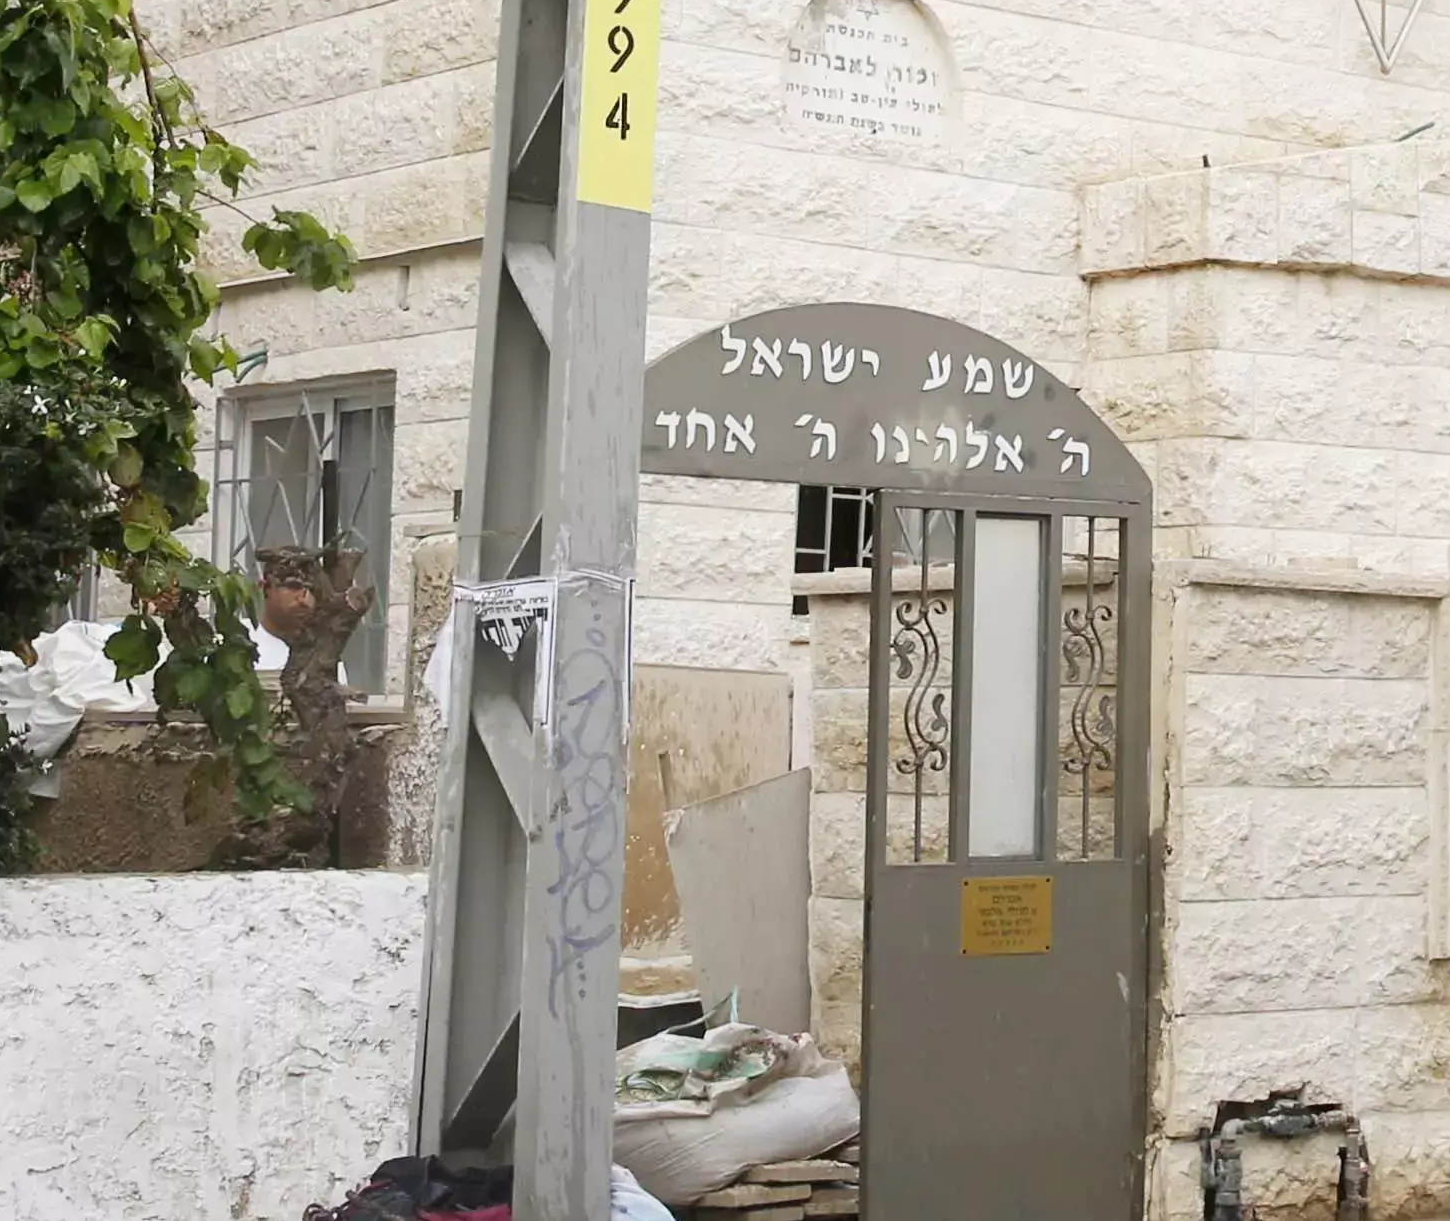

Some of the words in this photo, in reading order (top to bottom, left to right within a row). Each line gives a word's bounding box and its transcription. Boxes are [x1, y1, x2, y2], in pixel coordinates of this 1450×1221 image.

[788, 43, 876, 77] לאברהם
[722, 324, 879, 382] ישראל
[921, 350, 1034, 398] שמע
[656, 408, 755, 453] אחד
[870, 414, 1023, 471] אלהינו
